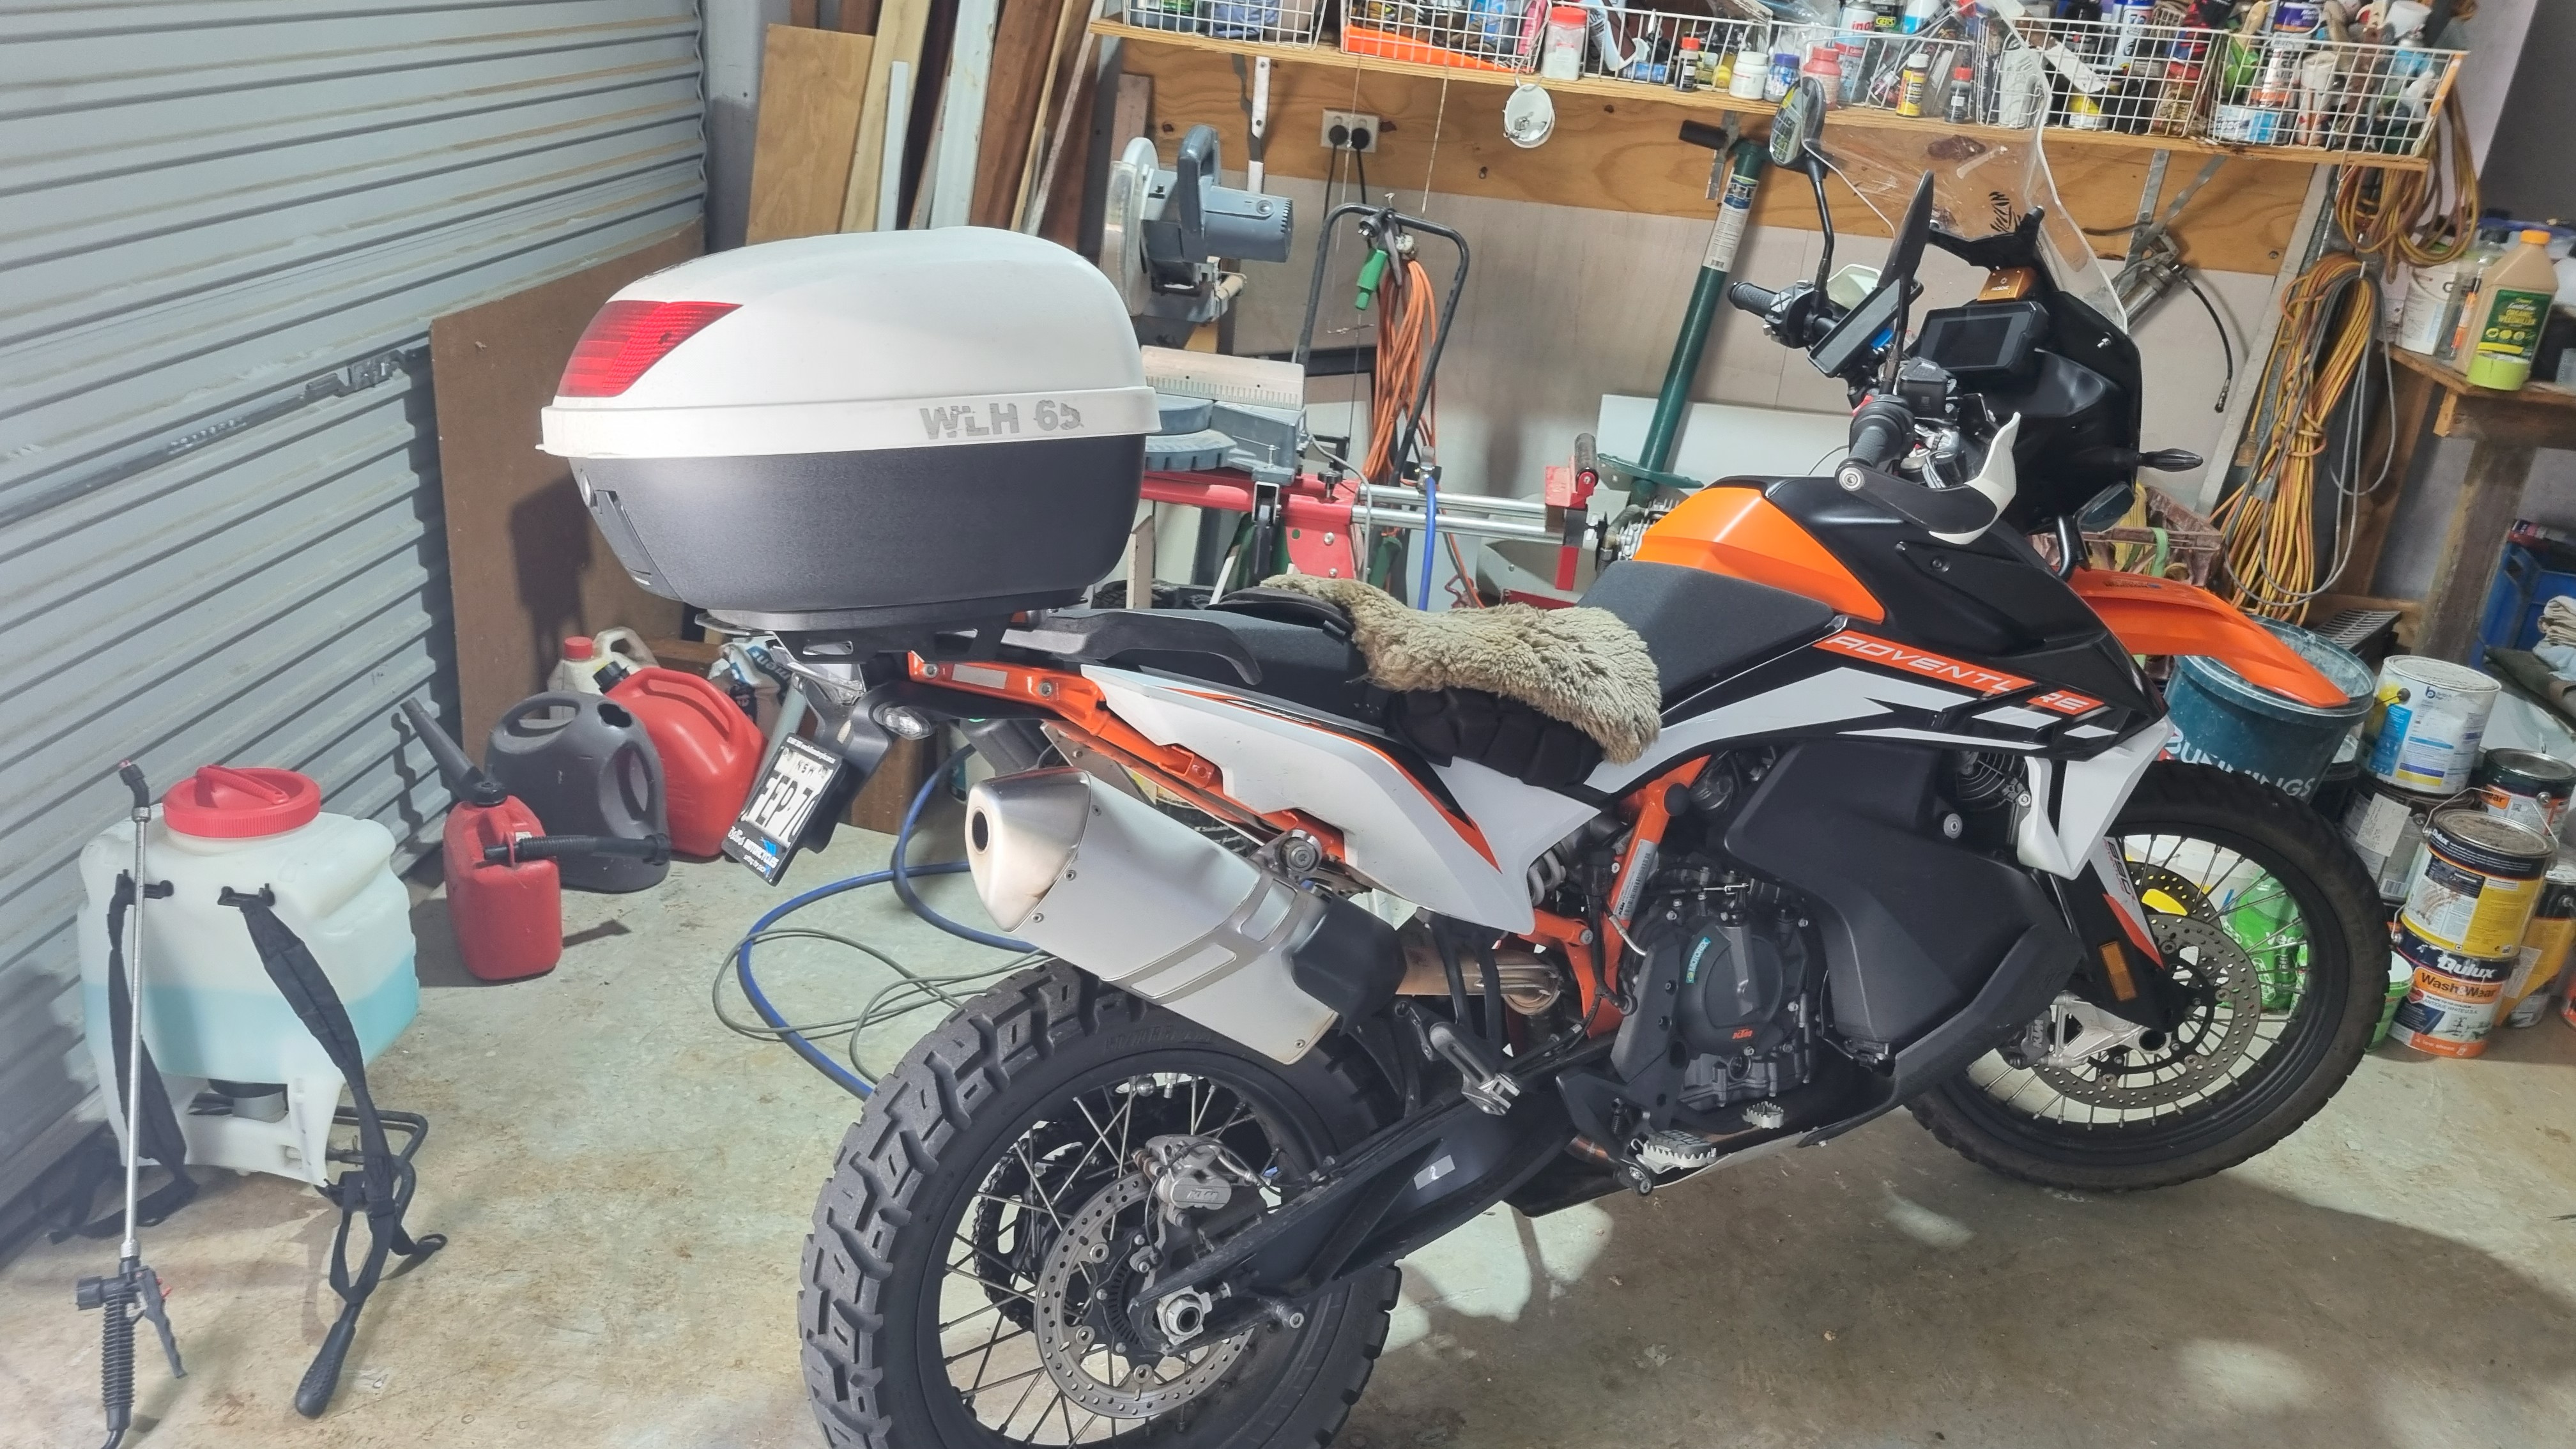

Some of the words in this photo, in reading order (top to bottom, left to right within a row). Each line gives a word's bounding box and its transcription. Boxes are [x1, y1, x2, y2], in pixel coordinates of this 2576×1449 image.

[919, 403, 1020, 440] WLH
[797, 760, 817, 777] NSW
[1689, 939, 1710, 973] MOTOREX
[2437, 958, 2497, 978] Dulux
[1731, 1028, 1753, 1040] KTM
[1186, 1187, 1219, 1202] KTM
